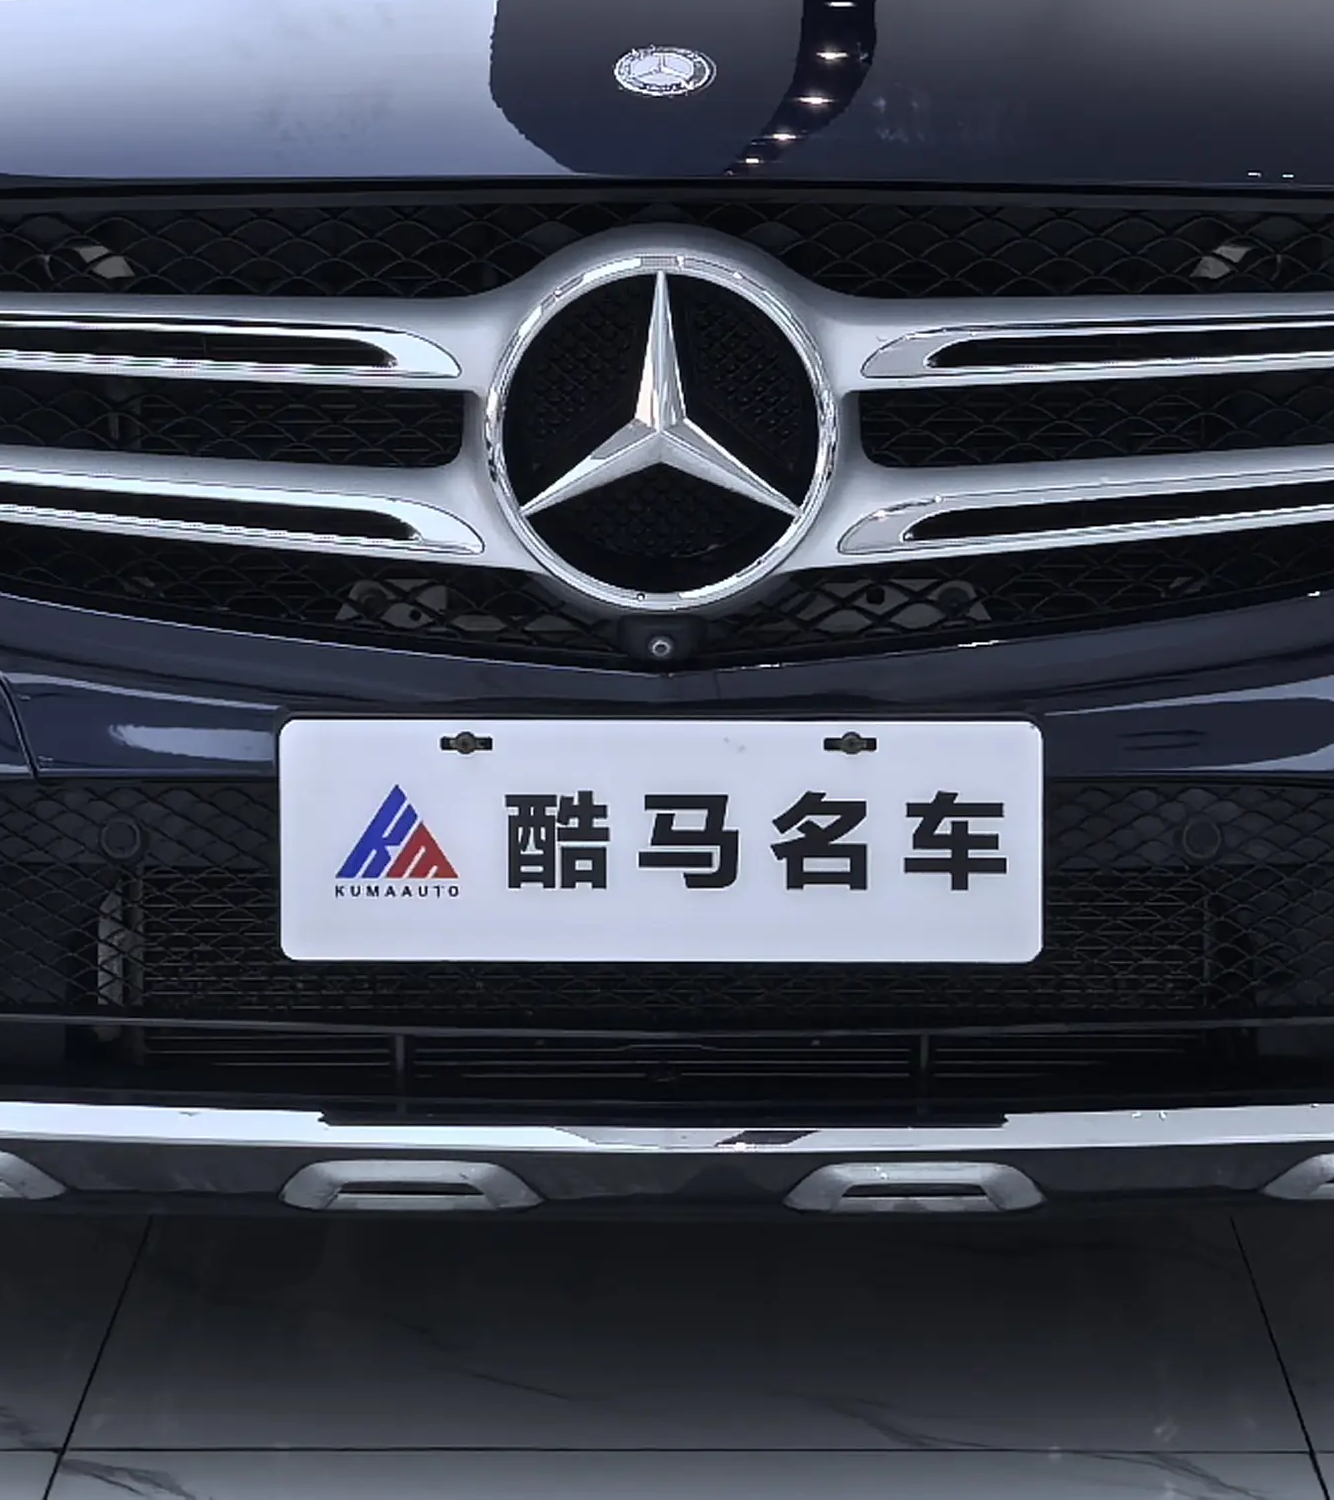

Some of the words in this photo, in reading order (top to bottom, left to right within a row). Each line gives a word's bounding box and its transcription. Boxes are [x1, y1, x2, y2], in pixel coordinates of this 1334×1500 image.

[505, 790, 1008, 891] 酷马名车
[334, 884, 460, 899] KUMAAUTO
